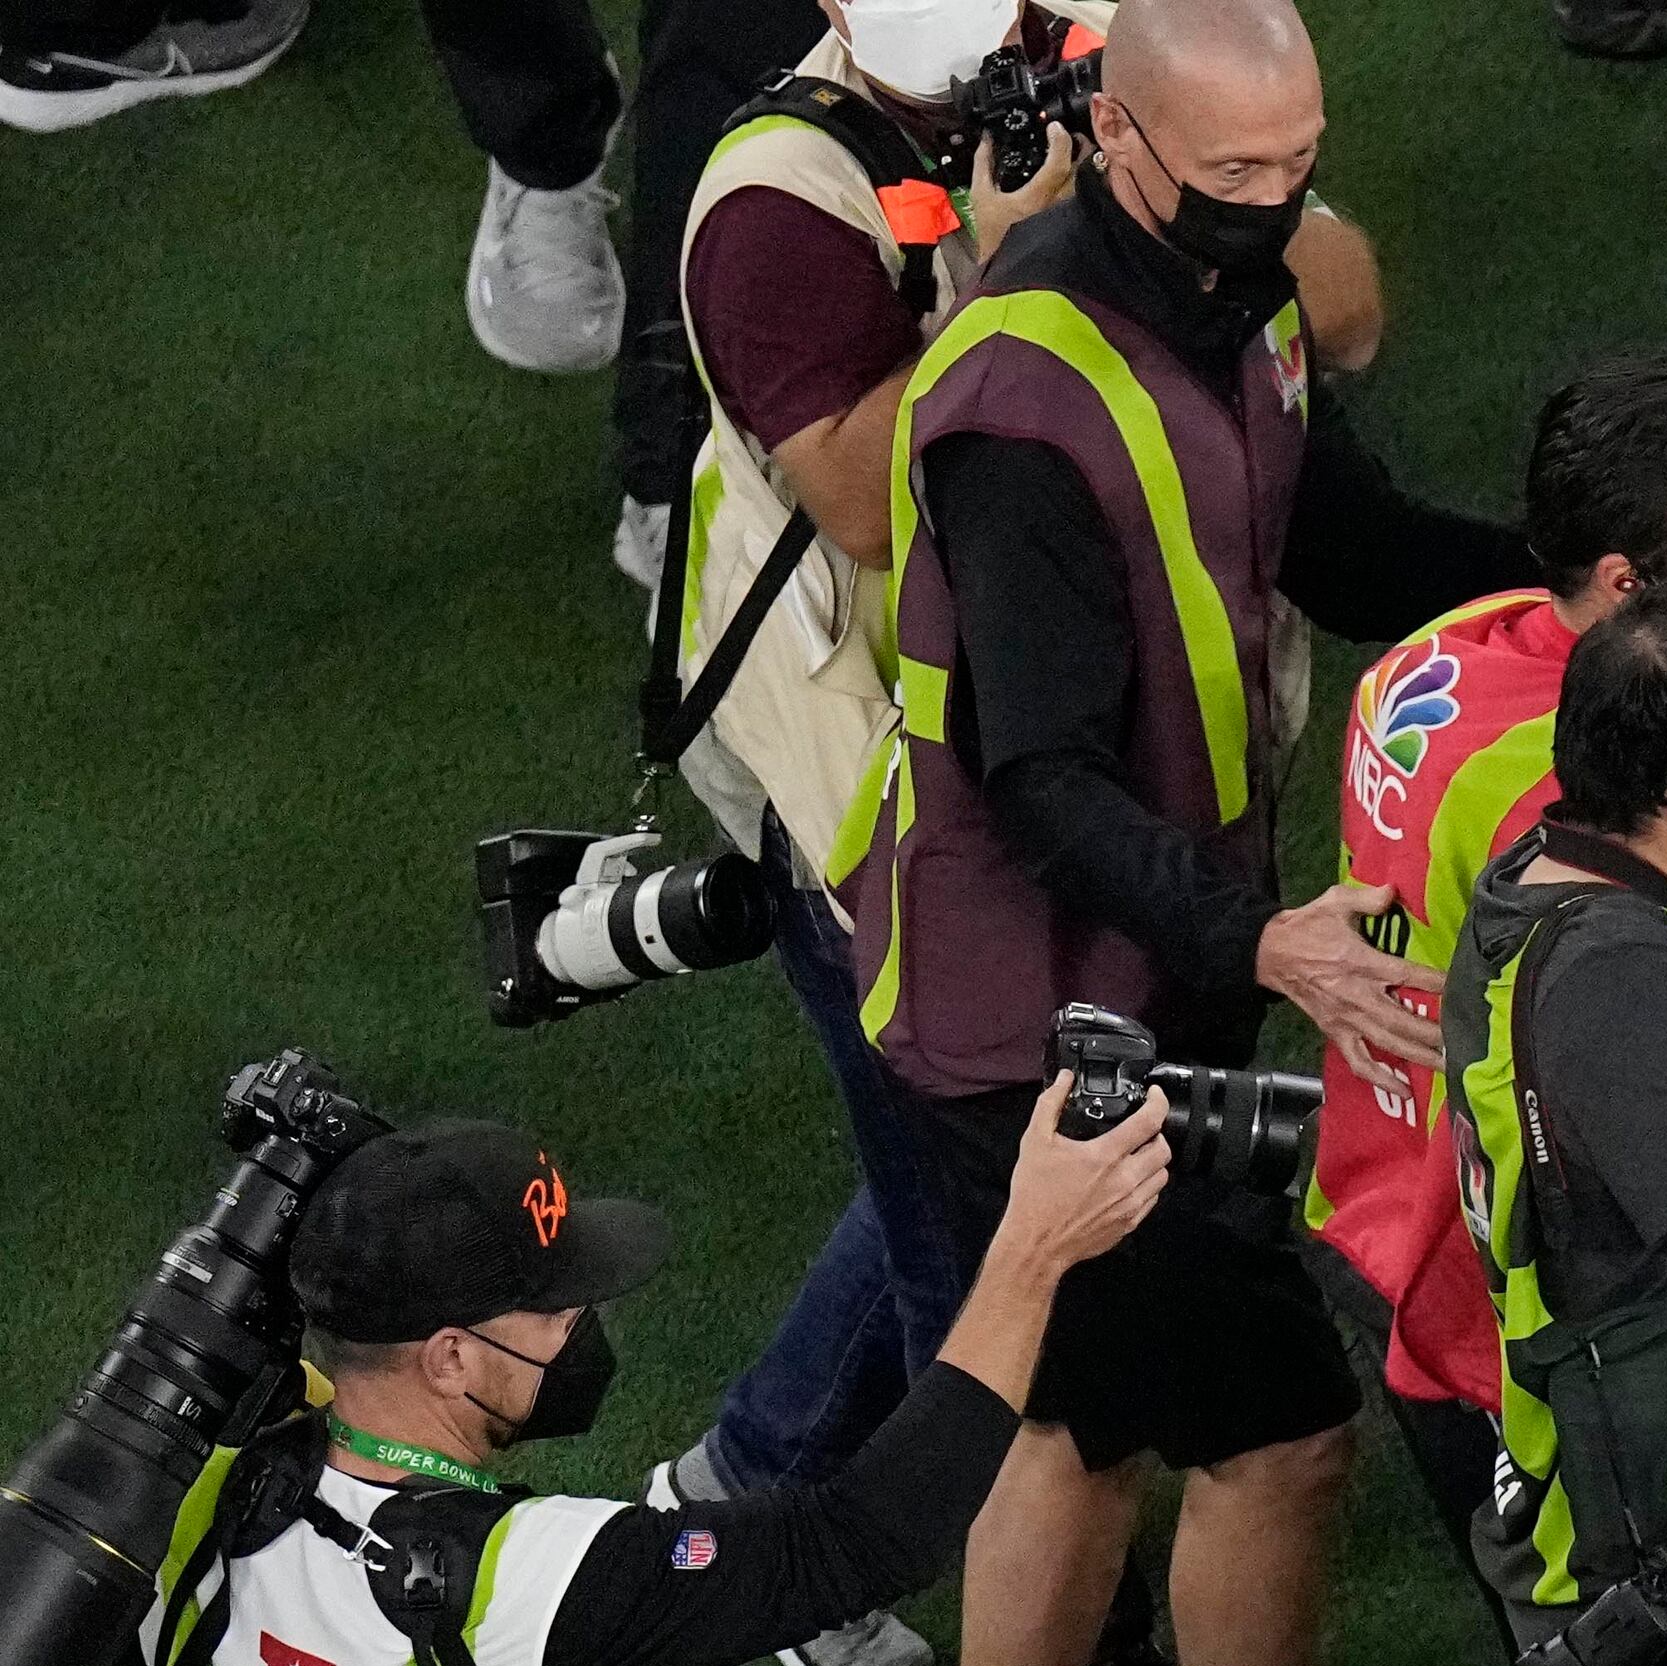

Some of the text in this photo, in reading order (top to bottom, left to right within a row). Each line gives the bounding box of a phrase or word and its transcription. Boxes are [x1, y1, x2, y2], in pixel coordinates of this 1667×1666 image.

[1346, 727, 1408, 841] NBC
[1525, 1088, 1550, 1164] Canon
[376, 1445, 436, 1470] SUPER
[438, 1457, 481, 1488] BOWL
[689, 1534, 711, 1565] NFL
